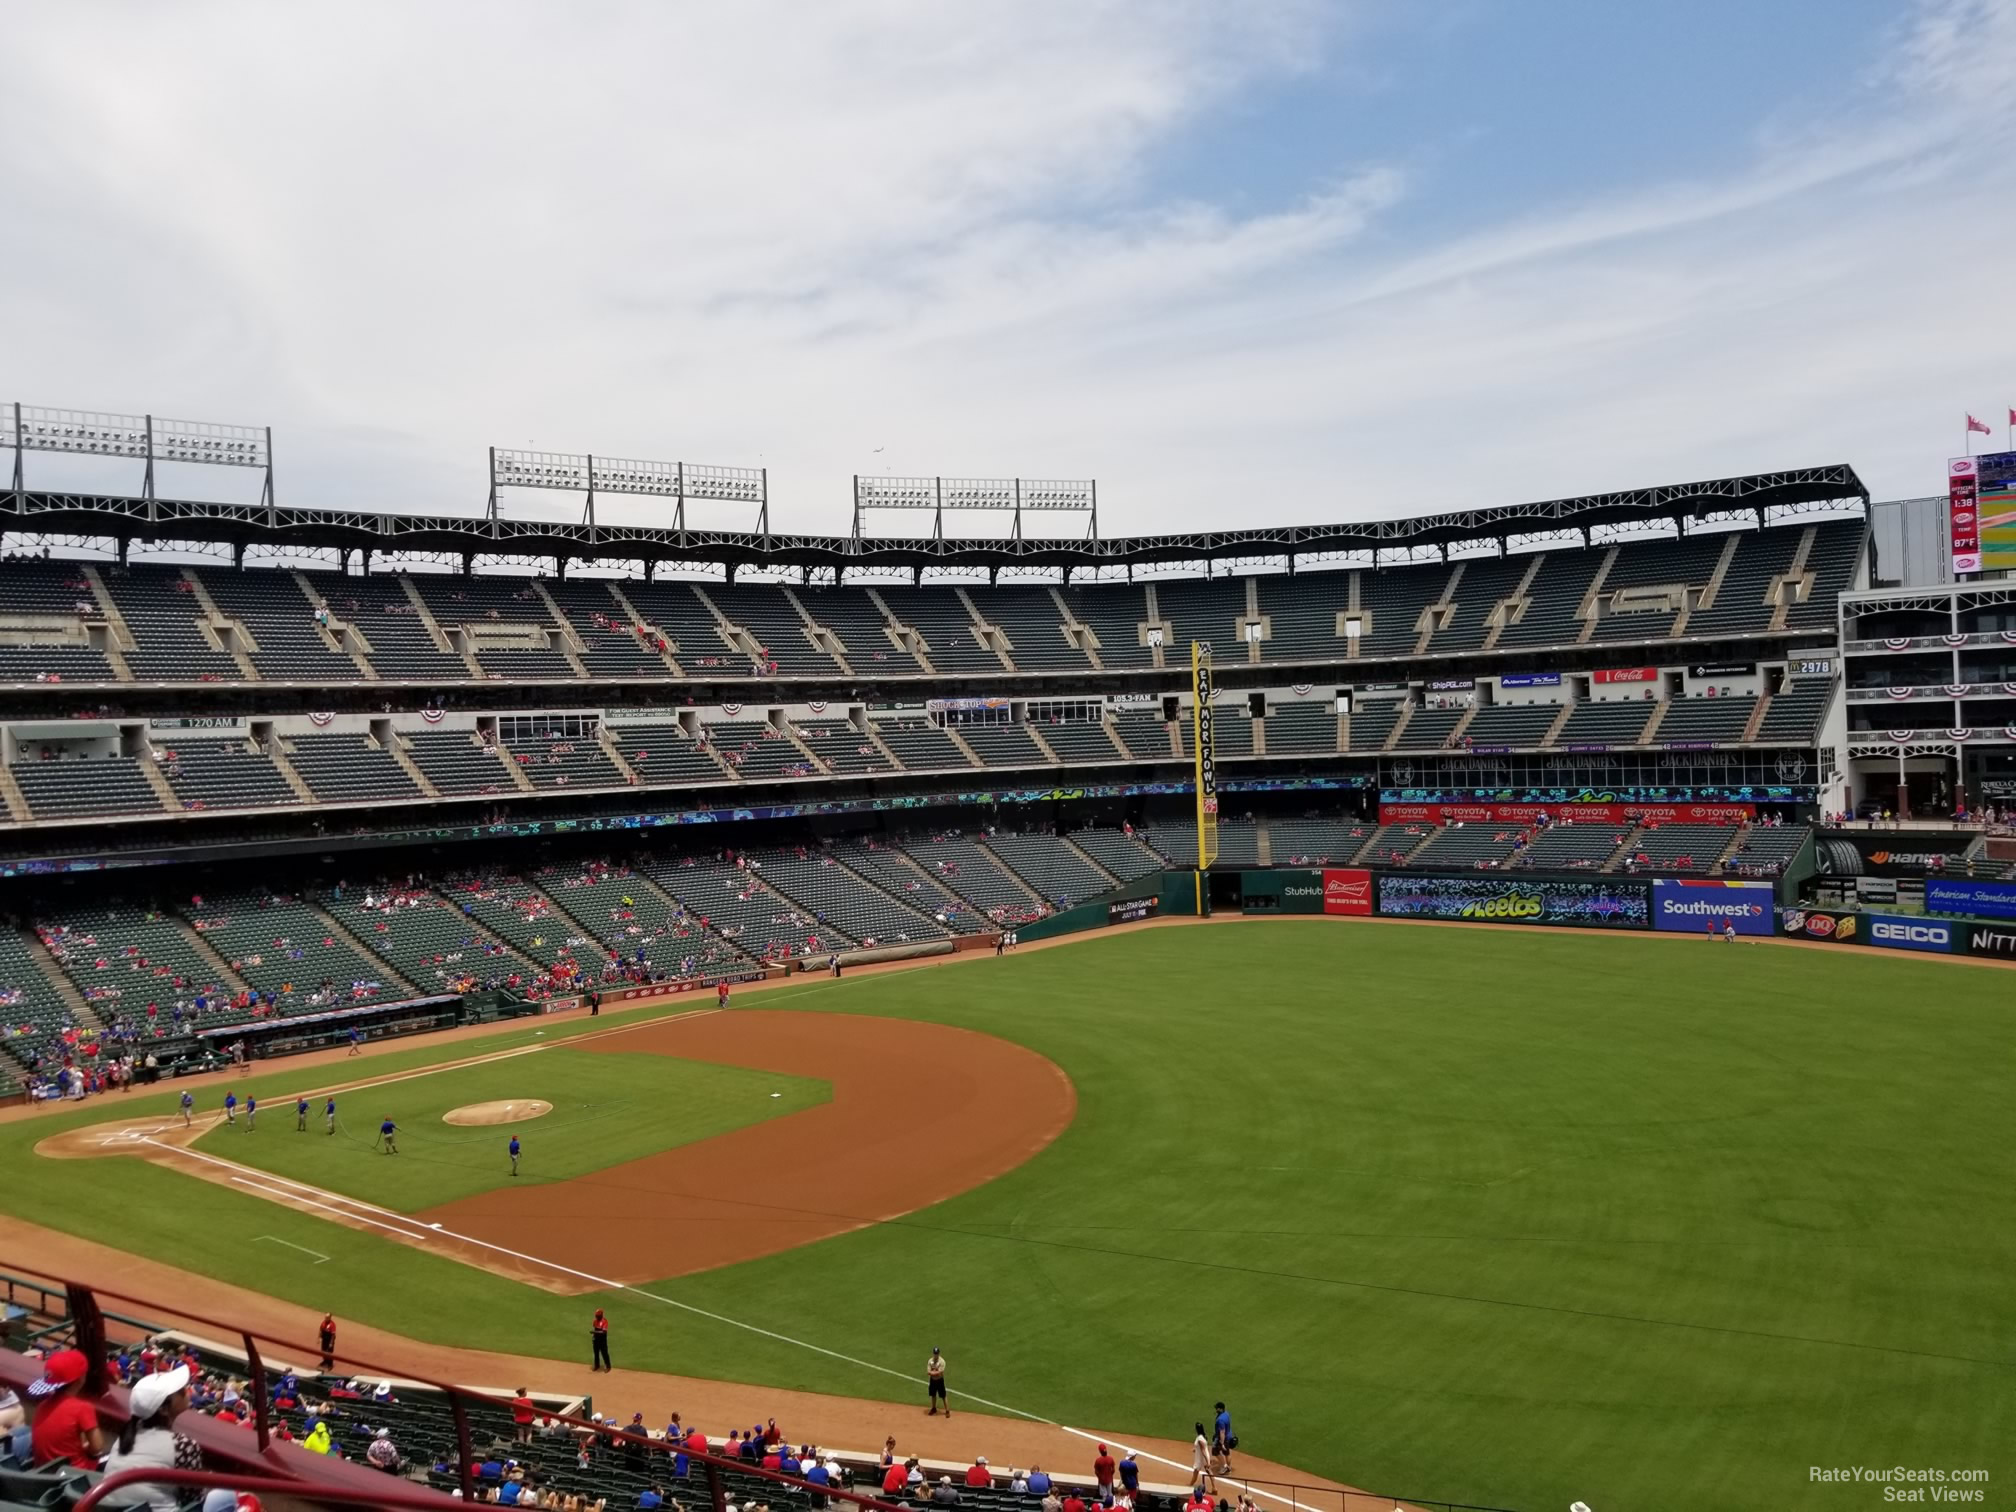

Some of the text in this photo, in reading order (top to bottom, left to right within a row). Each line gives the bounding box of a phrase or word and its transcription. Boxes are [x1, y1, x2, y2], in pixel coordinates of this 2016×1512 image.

[1954, 498, 1972, 508] 1:38
[1954, 538, 1975, 548] 87°F
[1802, 662, 1829, 673] 2978
[1432, 681, 1472, 690] ShipPGL.com
[930, 700, 981, 710] SHOCK TOP
[188, 719, 212, 727] 1270
[215, 718, 232, 727] AM
[1201, 708, 1210, 742] MOR
[1441, 758, 1506, 770] JACK DANIEL'S
[1546, 756, 1617, 768] JACK DANIEL'S
[1661, 753, 1738, 767] JACK DANIEL'S
[1203, 750, 1213, 793] FOWL
[1285, 887, 1323, 896] StubHub
[1330, 883, 1364, 891] Budweiser
[1930, 888, 1970, 899] American
[1138, 899, 1152, 908] GAME
[1664, 900, 1750, 916] Southwest
[1811, 919, 1830, 931] DQ
[1872, 923, 1948, 943] GEICO
